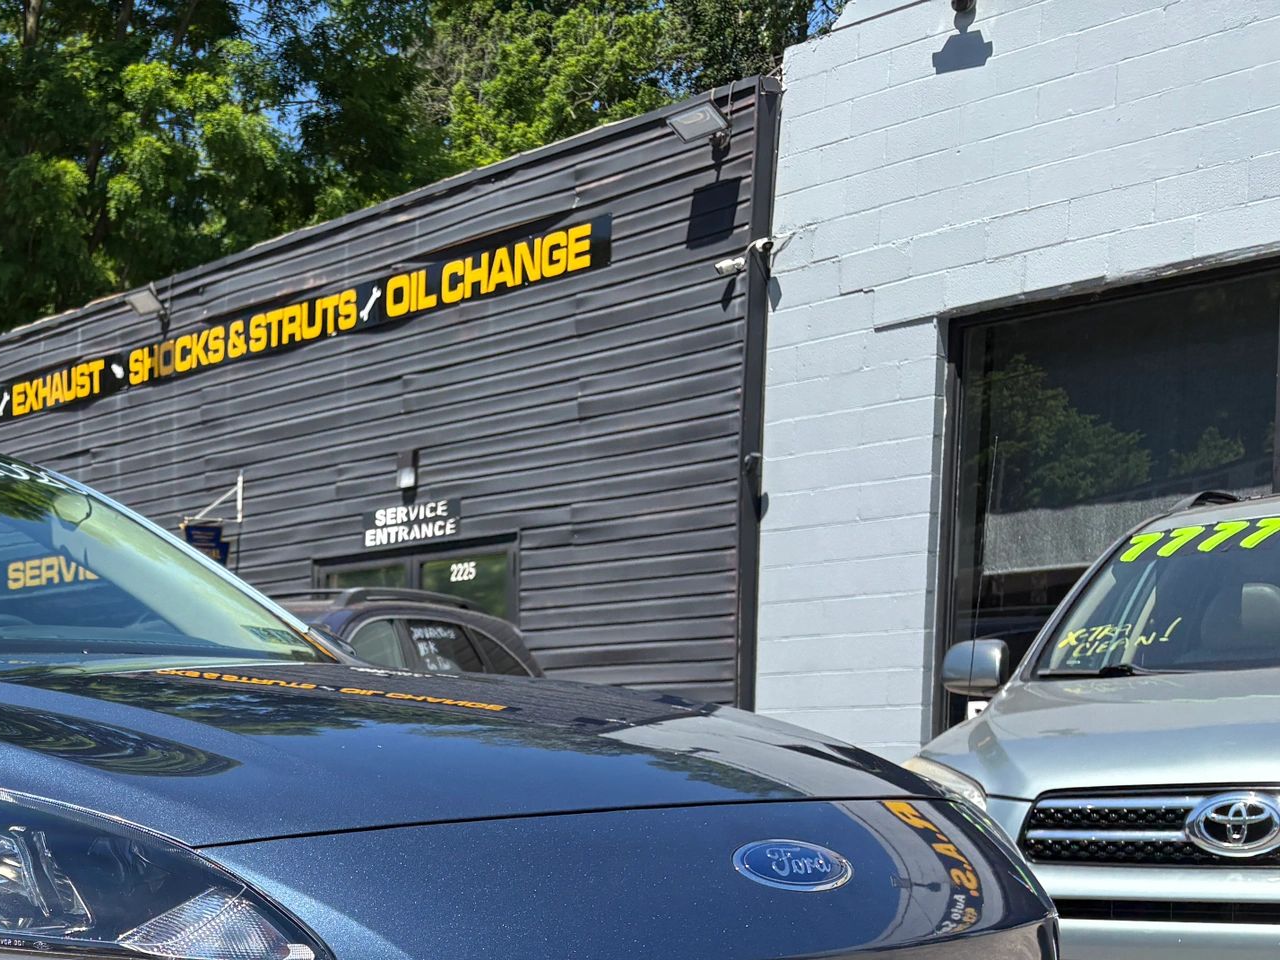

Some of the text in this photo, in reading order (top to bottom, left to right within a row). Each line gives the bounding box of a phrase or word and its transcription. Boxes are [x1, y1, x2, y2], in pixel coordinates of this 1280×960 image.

[12, 359, 105, 416] EXHAUST
[129, 325, 225, 386] SHOCKS
[227, 319, 247, 360] &
[249, 288, 357, 353] STRUTS
[386, 269, 437, 318] OIL
[441, 223, 593, 304] CHANGE
[375, 500, 448, 527] SERVICE
[365, 517, 457, 547] ENTRANCE
[450, 561, 477, 582] 2225
[766, 847, 831, 877] Ford
